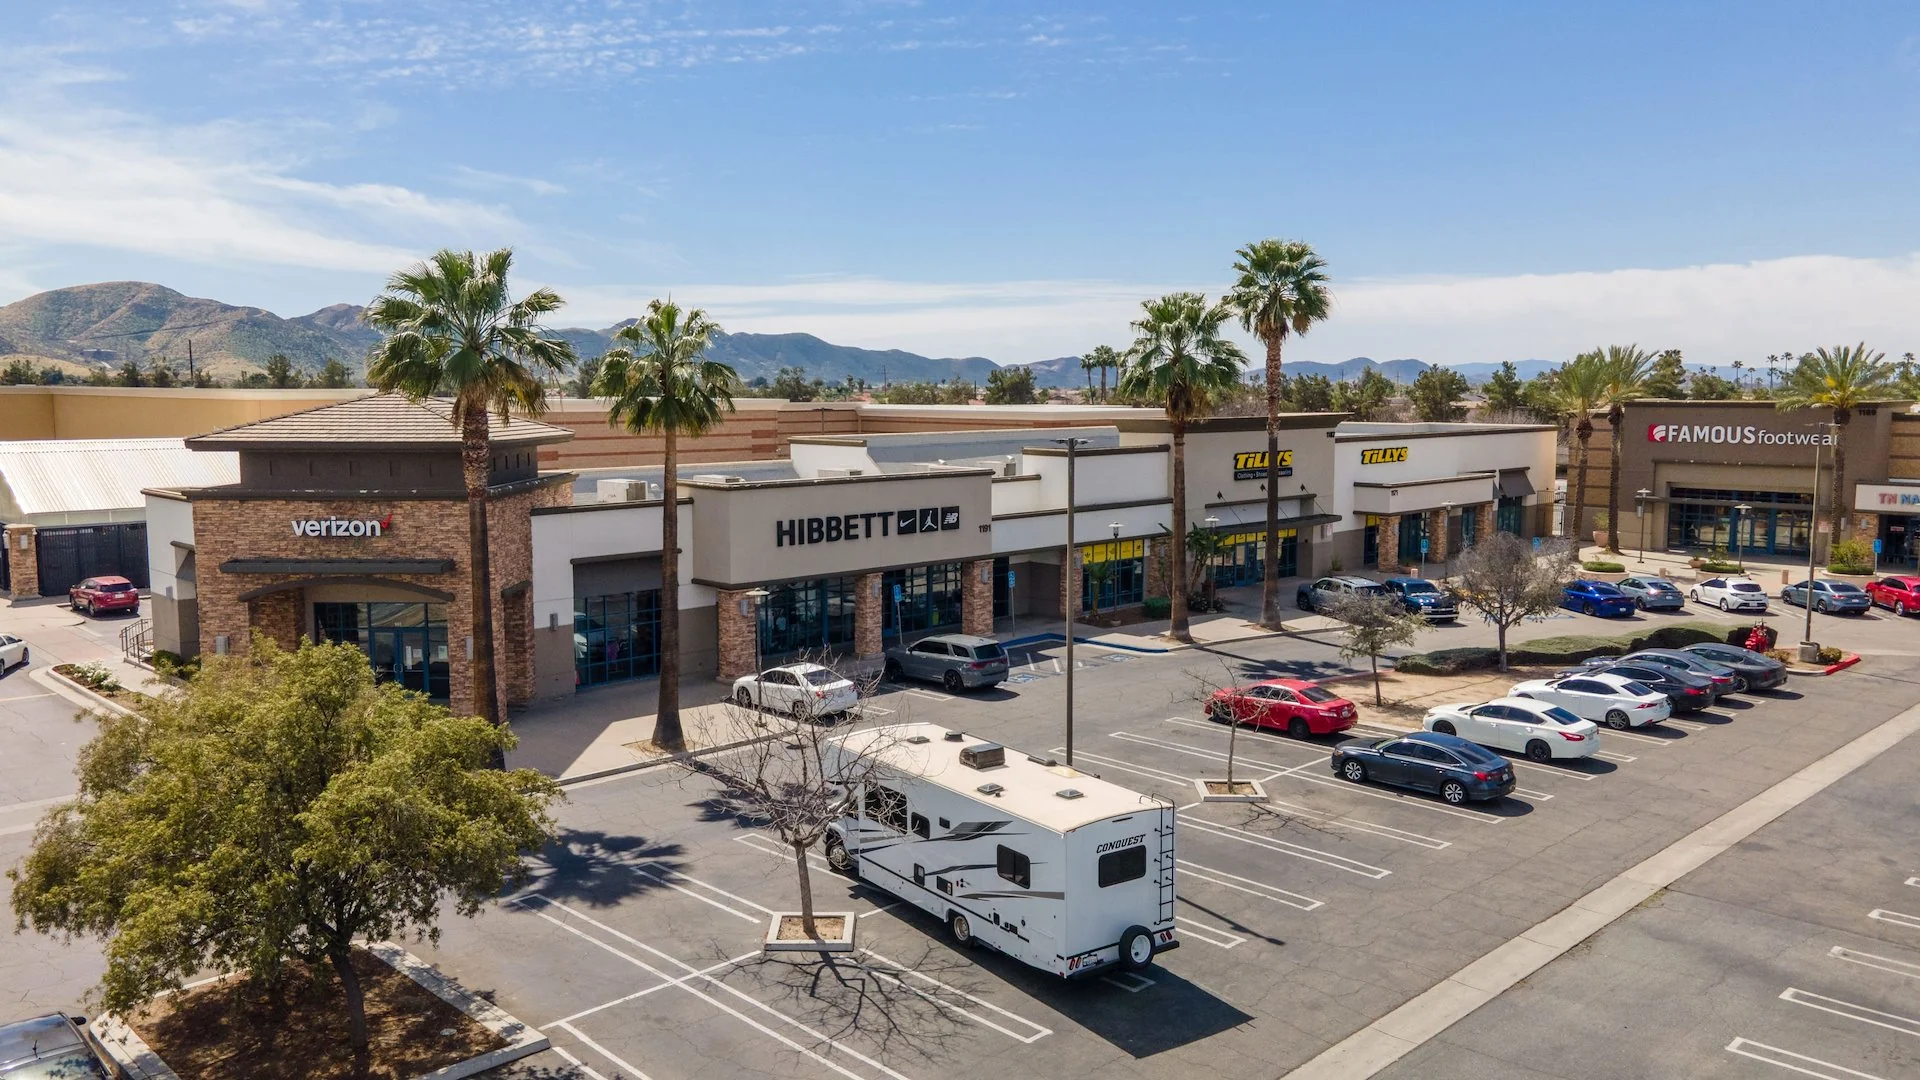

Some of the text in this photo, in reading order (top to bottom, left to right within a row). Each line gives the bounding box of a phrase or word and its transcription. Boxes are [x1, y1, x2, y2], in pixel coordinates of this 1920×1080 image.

[1668, 424, 1756, 444] FAMOUS
[1879, 493, 1898, 505] TN
[291, 515, 381, 537] verizon
[776, 511, 895, 547] HIBBETT
[1096, 834, 1146, 854] CONQUEST
